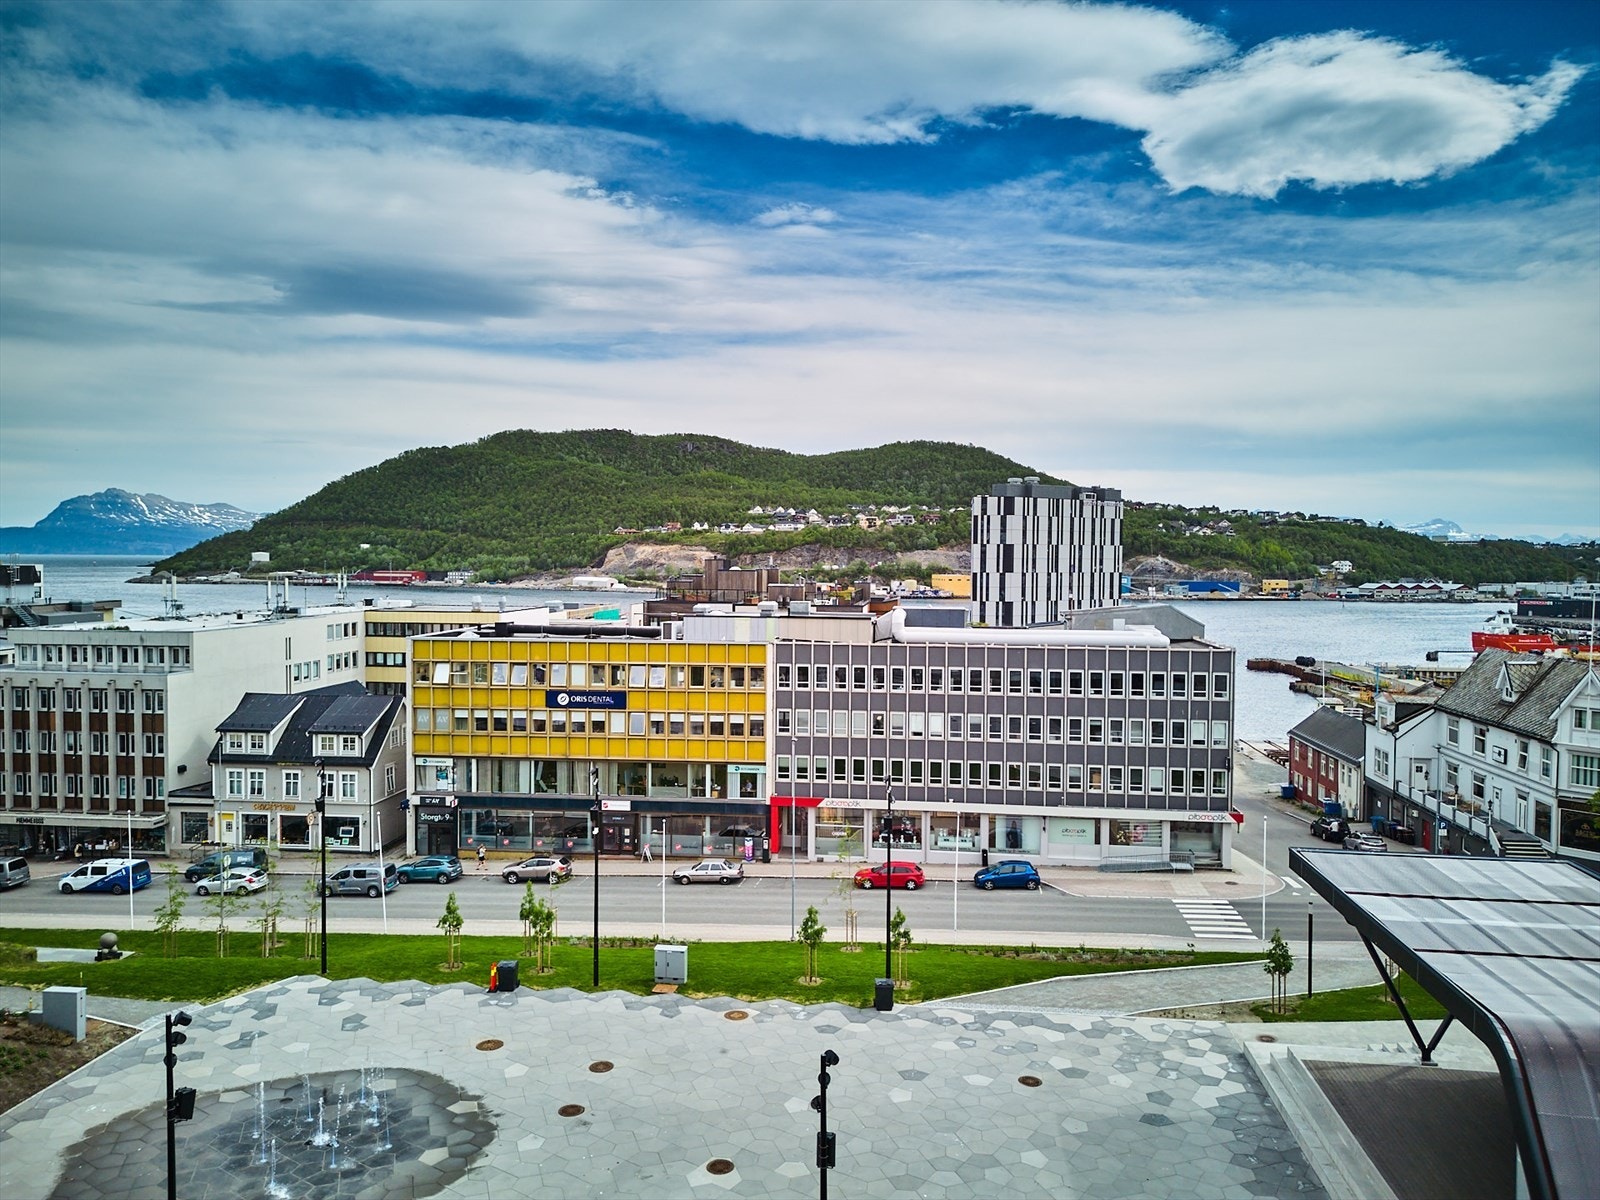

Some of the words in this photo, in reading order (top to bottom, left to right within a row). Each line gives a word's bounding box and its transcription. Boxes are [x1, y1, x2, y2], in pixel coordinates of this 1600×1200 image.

[570, 695, 587, 703] ORIS
[588, 695, 614, 704] DENTAL
[444, 813, 450, 821] 9
